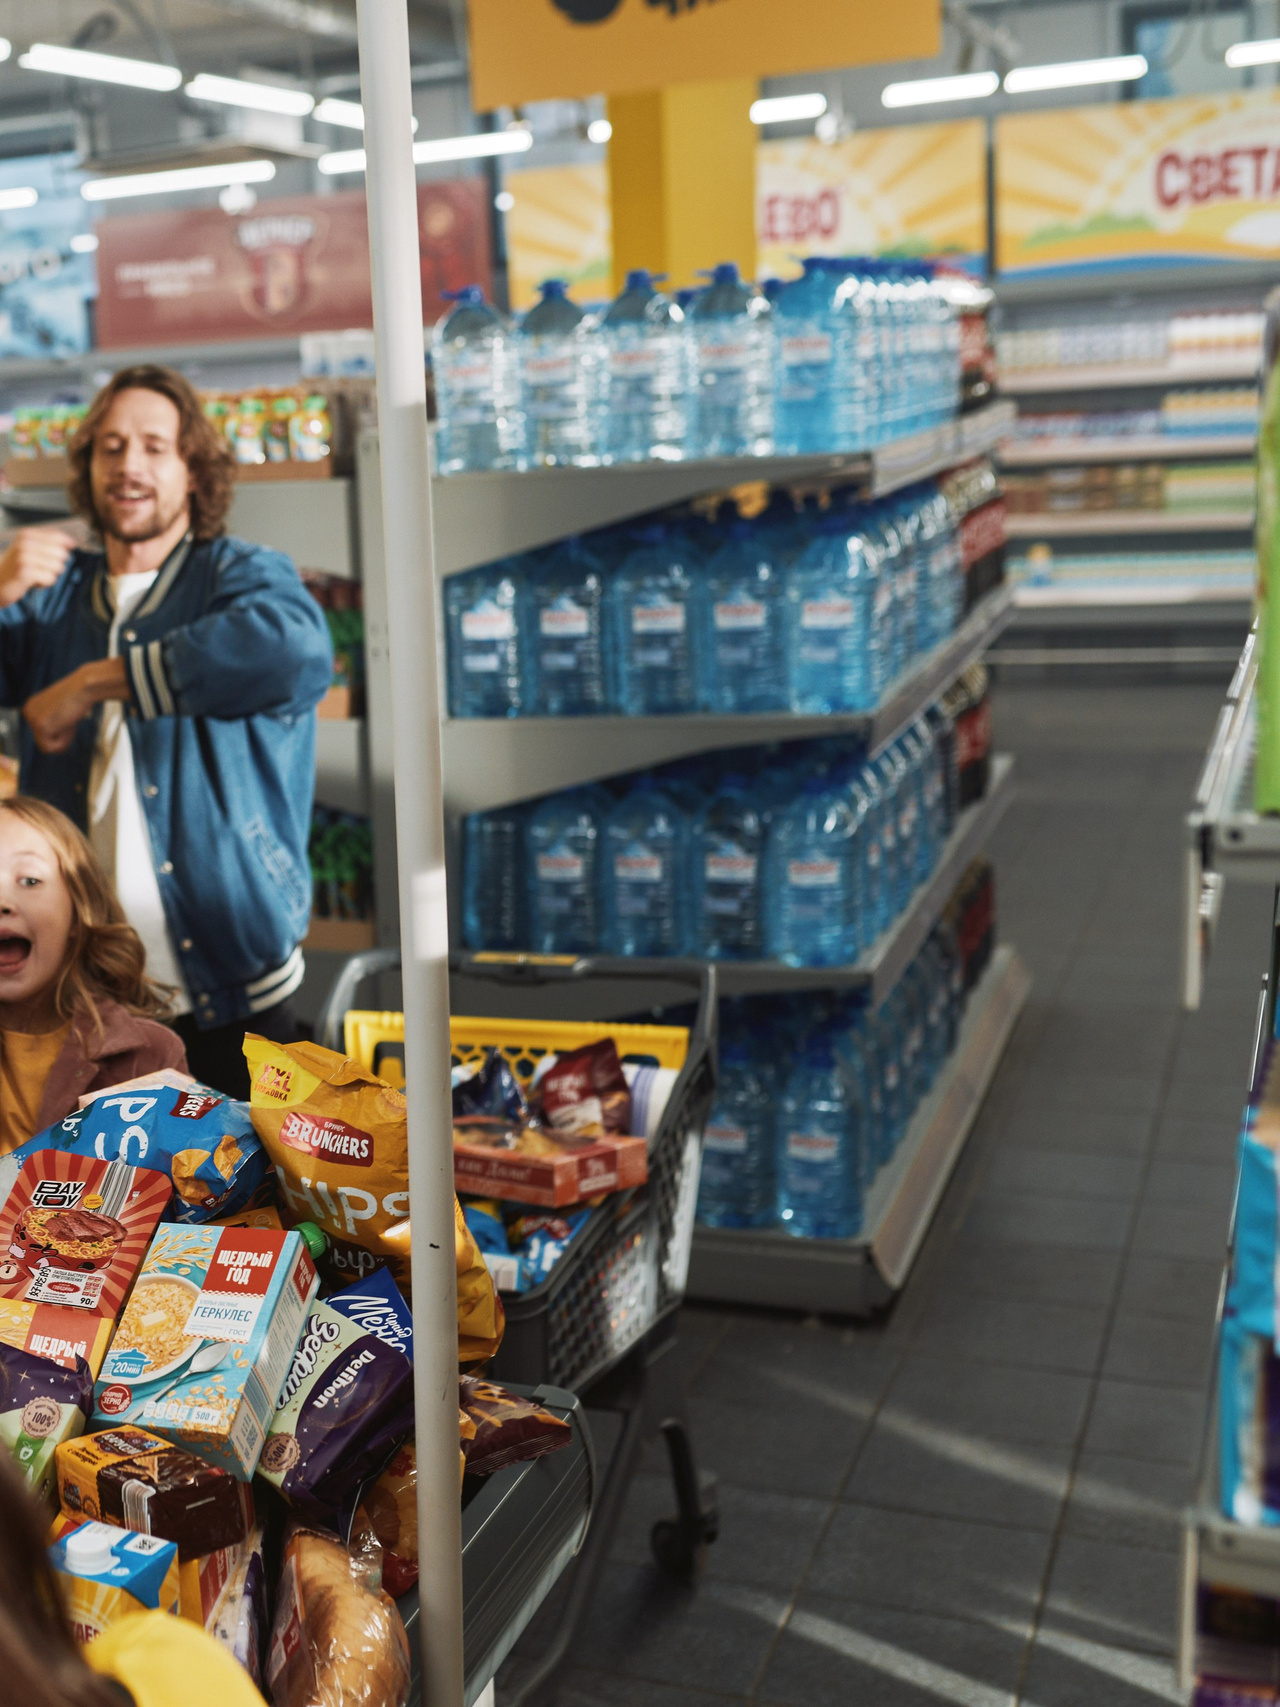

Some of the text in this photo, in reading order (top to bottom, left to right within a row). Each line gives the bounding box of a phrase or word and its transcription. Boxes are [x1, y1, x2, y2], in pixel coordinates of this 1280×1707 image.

[258, 1063, 291, 1092] XXL
[287, 1120, 369, 1159] BRUNCHERS
[216, 1250, 273, 1268] ЩЕДРЫЙ
[225, 1267, 251, 1285] ГОД
[80, 1297, 94, 1306] 90г
[193, 1306, 252, 1322] ГЕРКУЛЕС
[228, 1328, 247, 1336] ГОСТ
[30, 1334, 87, 1358] ЩЕДРЫЙ
[113, 1362, 141, 1375] 20 МИН
[312, 1349, 376, 1409] Delibon
[102, 1397, 122, 1405] ЗЕРНО
[31, 1411, 54, 1428] 100%
[196, 1411, 210, 1421] 500
